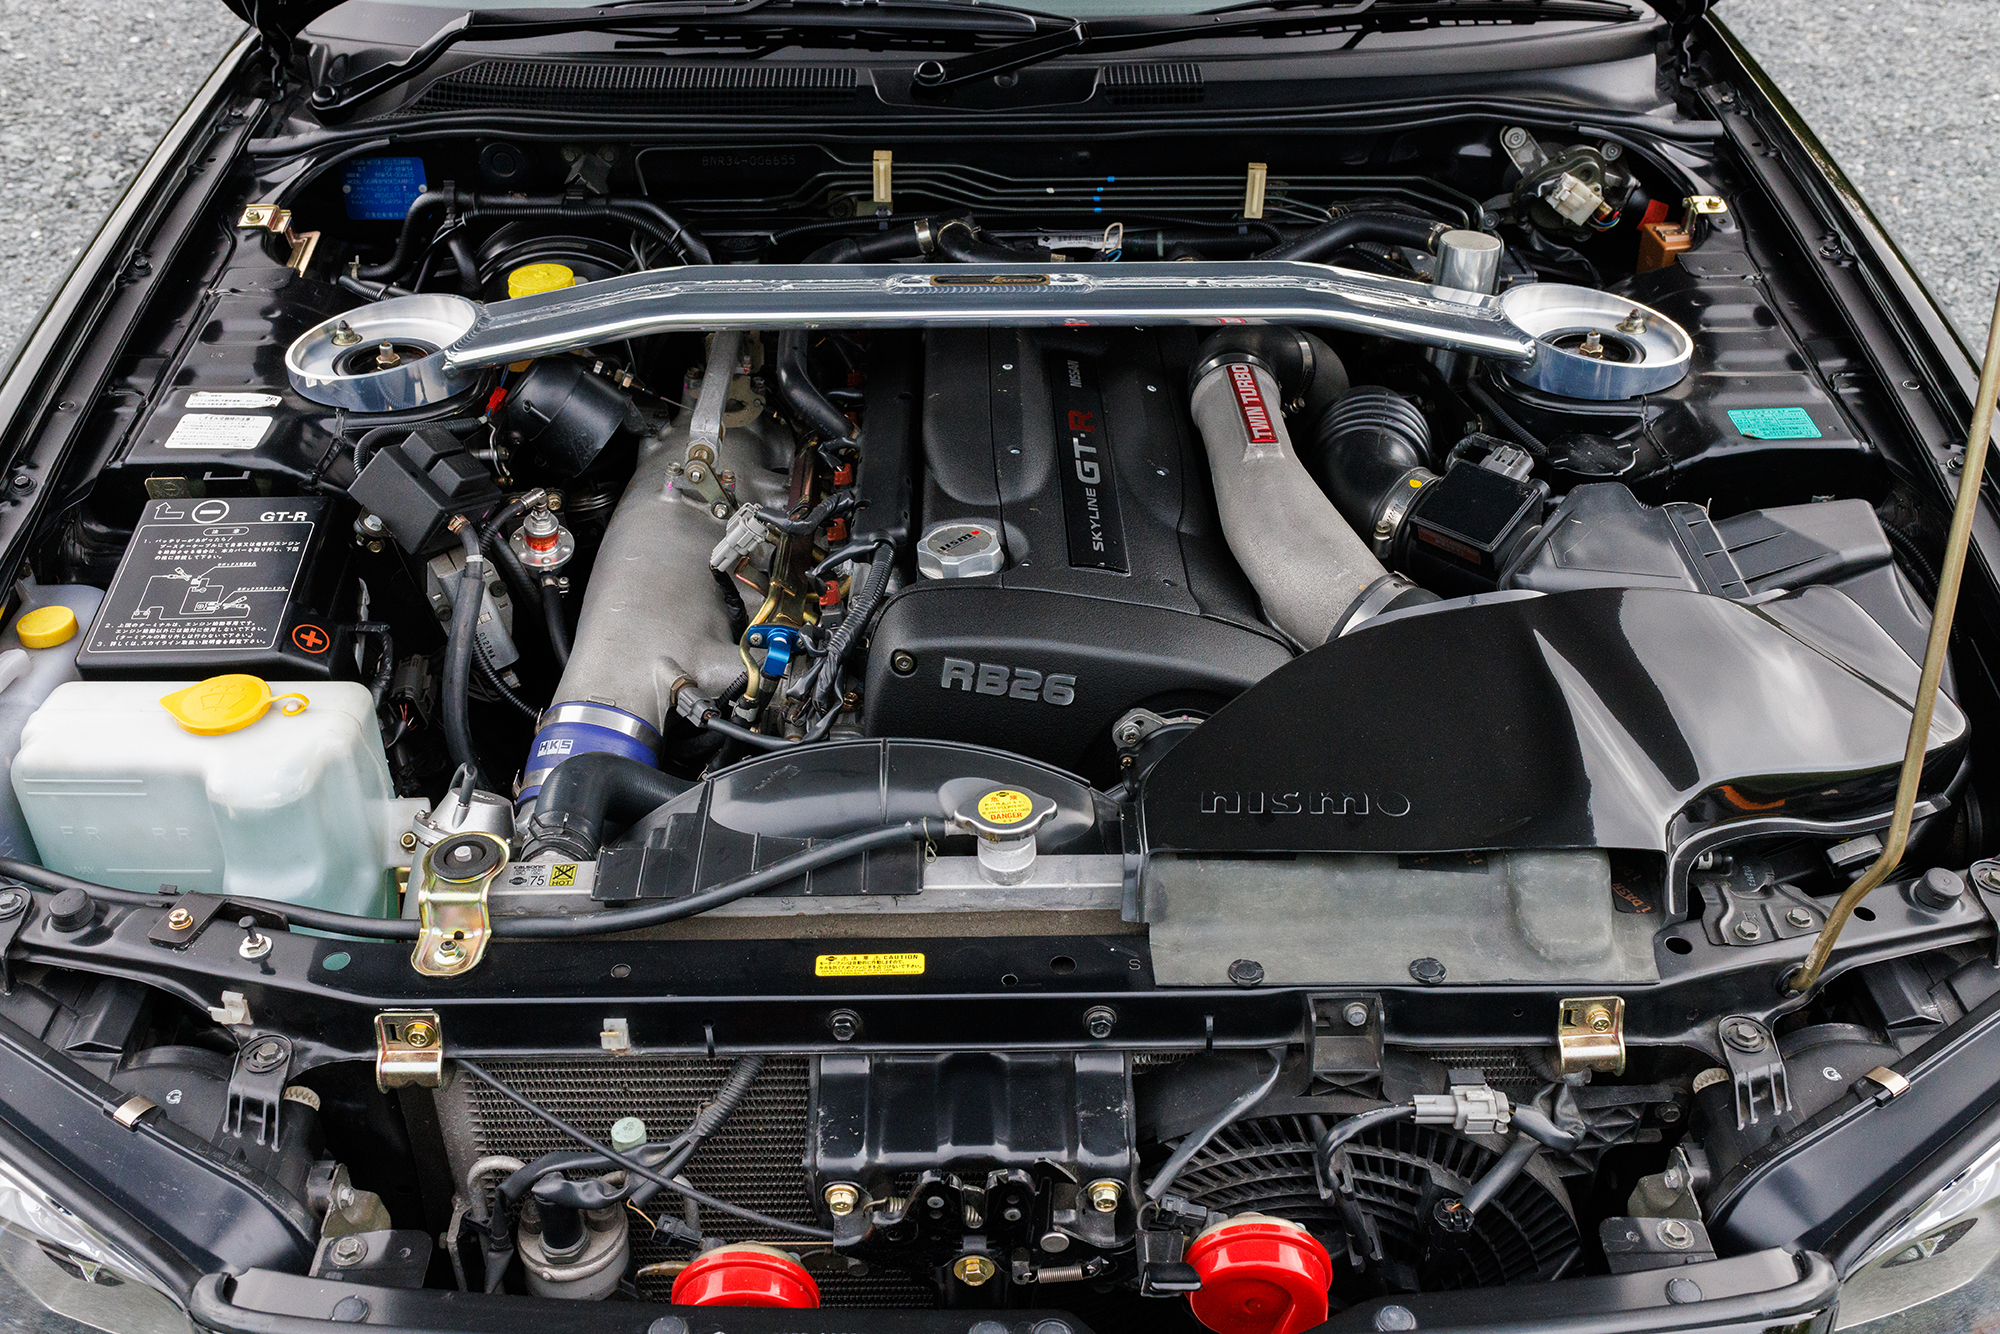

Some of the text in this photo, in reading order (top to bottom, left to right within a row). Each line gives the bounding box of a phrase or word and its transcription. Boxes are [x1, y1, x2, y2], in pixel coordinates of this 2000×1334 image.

[702, 155, 796, 166] BNR34-006655
[1067, 359, 1082, 388] NISSAN
[1231, 365, 1272, 439] TWIN TURBO
[260, 511, 308, 522] GT-R
[1086, 487, 1104, 551] SKYLINE
[941, 656, 1077, 706] RB26
[538, 740, 572, 754] HKS
[1201, 791, 1411, 817] nismo
[990, 812, 1023, 820] DANGER
[530, 875, 545, 886] 75
[1128, 959, 1141, 971] S
